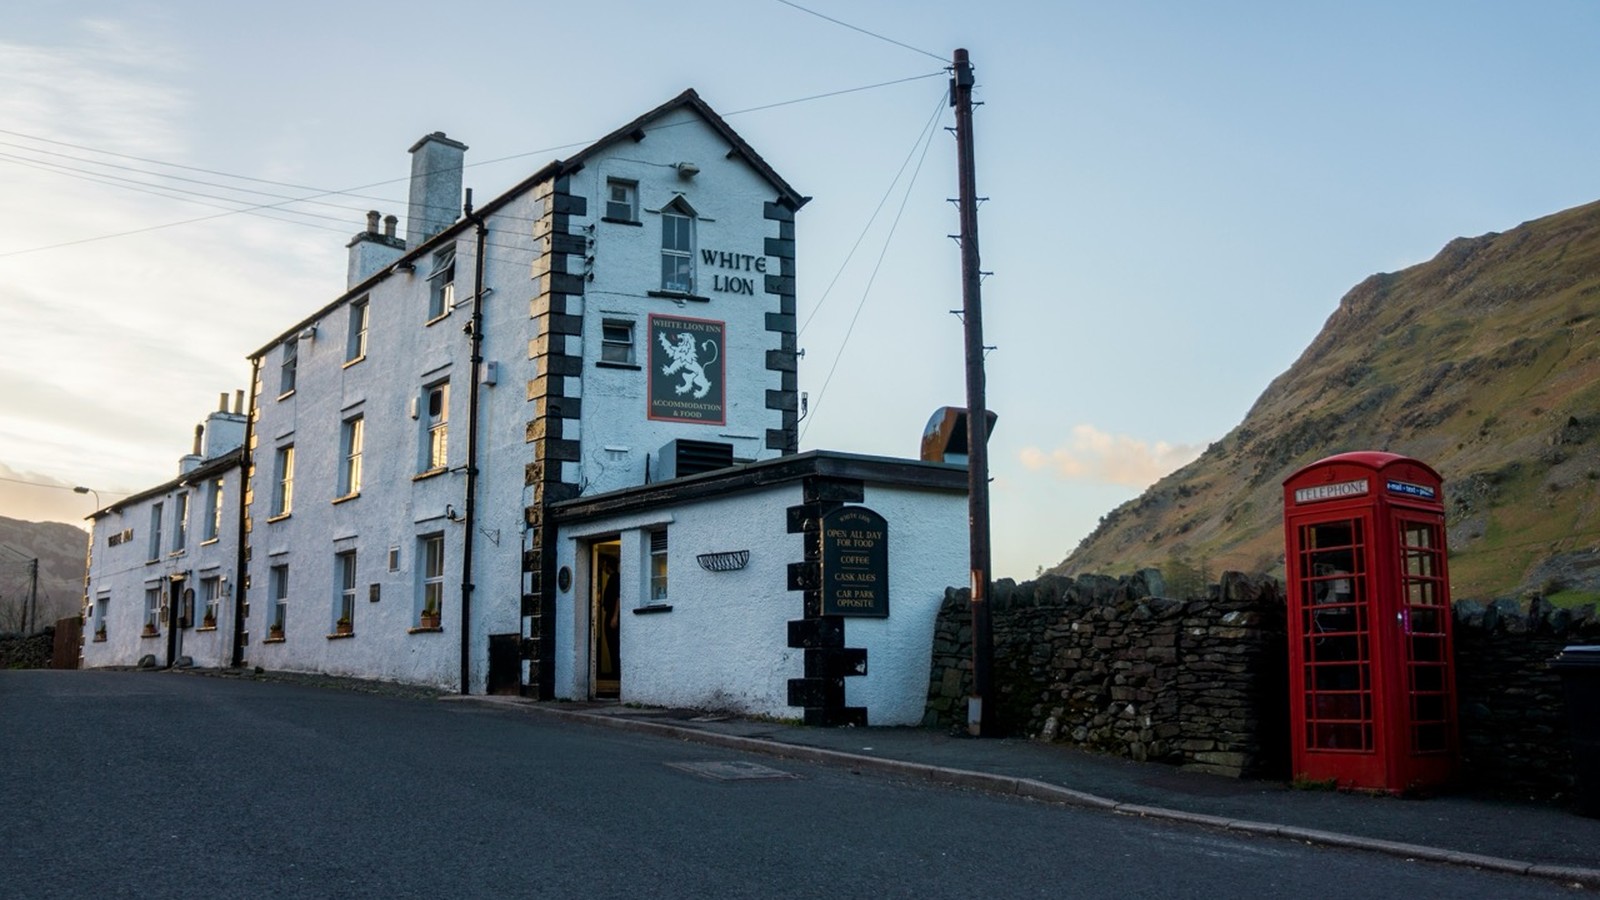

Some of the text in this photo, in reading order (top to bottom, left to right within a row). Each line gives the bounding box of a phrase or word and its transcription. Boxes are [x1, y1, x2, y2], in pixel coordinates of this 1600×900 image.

[701, 249, 767, 273] WHITE
[713, 275, 754, 296] LION
[653, 319, 722, 333] WHITE LION INN
[652, 399, 722, 411] ACCOMMODATION
[680, 410, 702, 418] FOOD
[1299, 480, 1366, 500] TELEPHONE
[827, 529, 882, 540] OPEN ALL DAY
[836, 539, 874, 548] FOR FOOD
[840, 556, 870, 565] COFFEE
[834, 573, 876, 582] CASK ALES
[836, 590, 875, 599] CAR PARK
[837, 599, 874, 608] OPPOSITE
